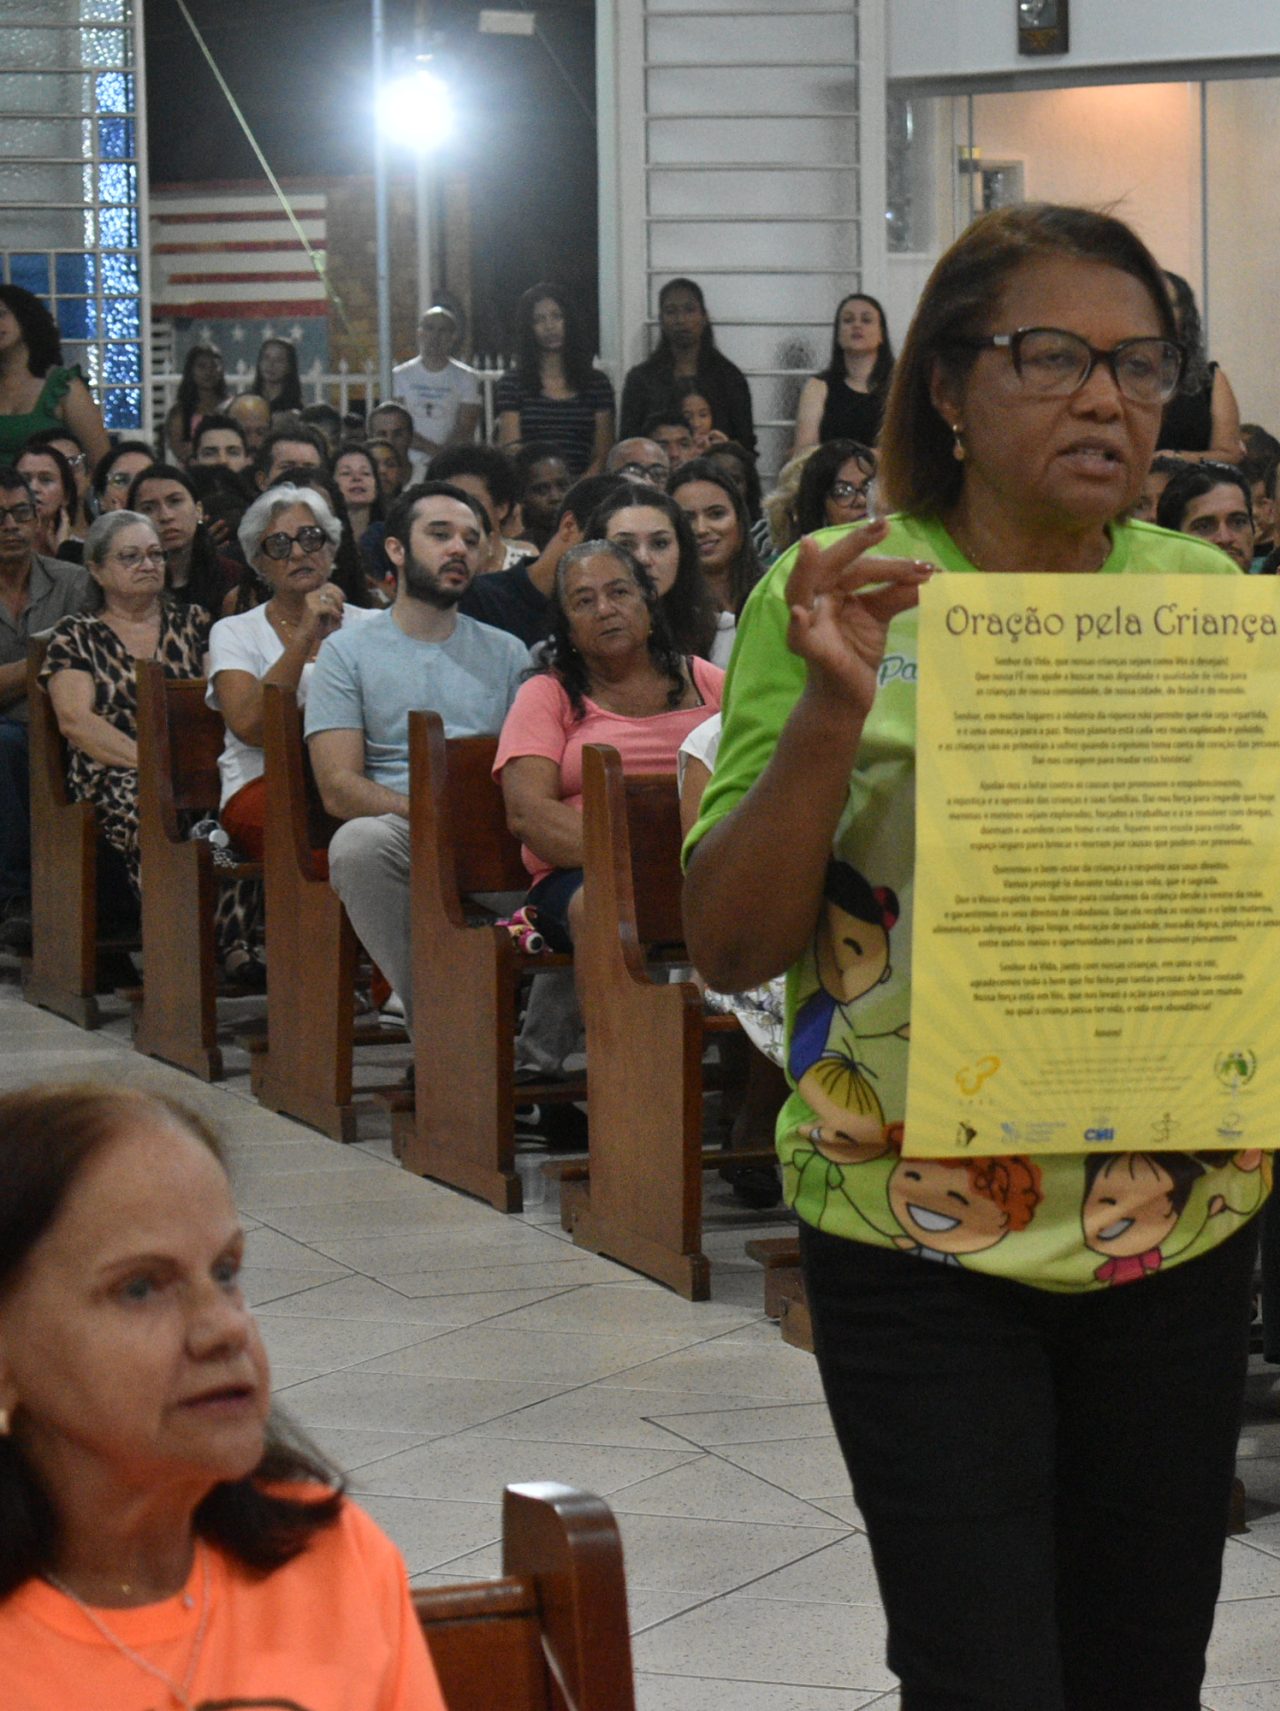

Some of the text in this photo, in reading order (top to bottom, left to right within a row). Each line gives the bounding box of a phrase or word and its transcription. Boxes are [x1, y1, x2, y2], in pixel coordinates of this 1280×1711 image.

[945, 603, 1277, 643] Oração pela Criança
